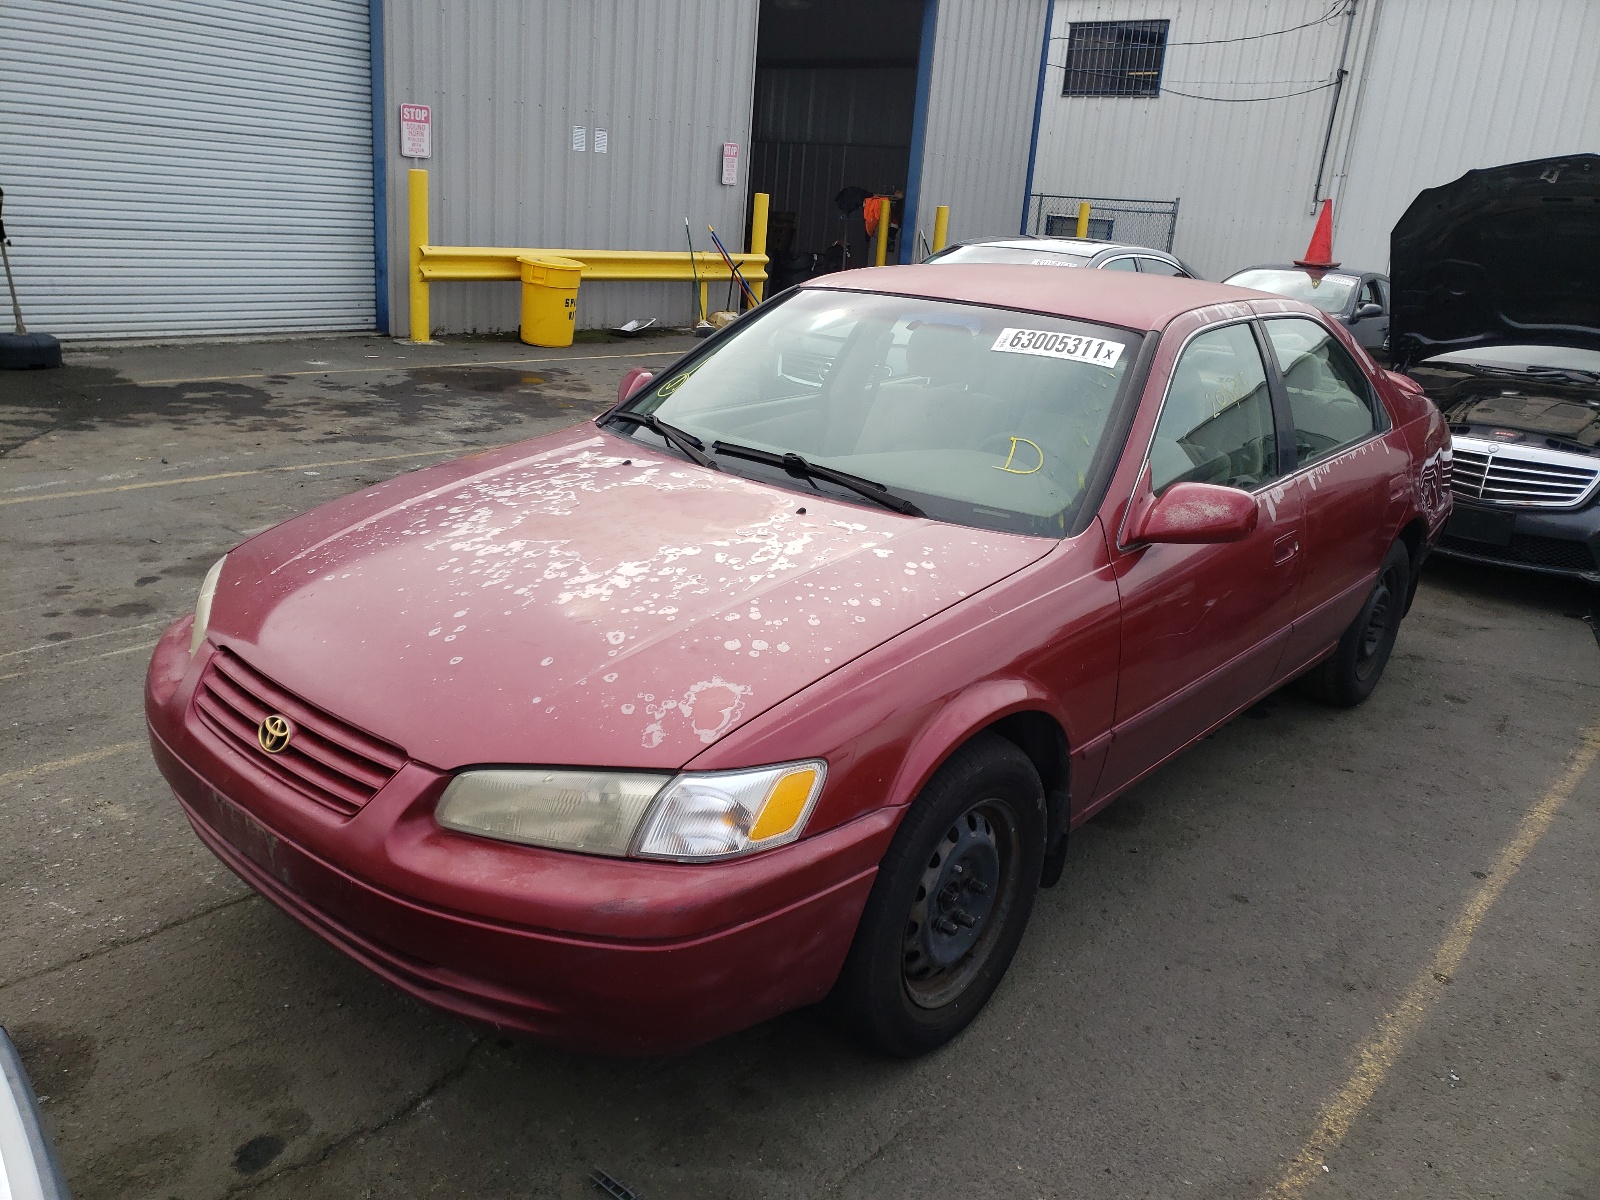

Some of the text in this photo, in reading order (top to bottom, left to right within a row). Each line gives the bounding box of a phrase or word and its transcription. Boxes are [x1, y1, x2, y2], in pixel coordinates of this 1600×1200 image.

[403, 107, 428, 121] STOP
[406, 123, 426, 131] SOUND
[407, 129, 425, 137] HORN
[724, 146, 737, 156] STOP
[991, 436, 1044, 475] D
